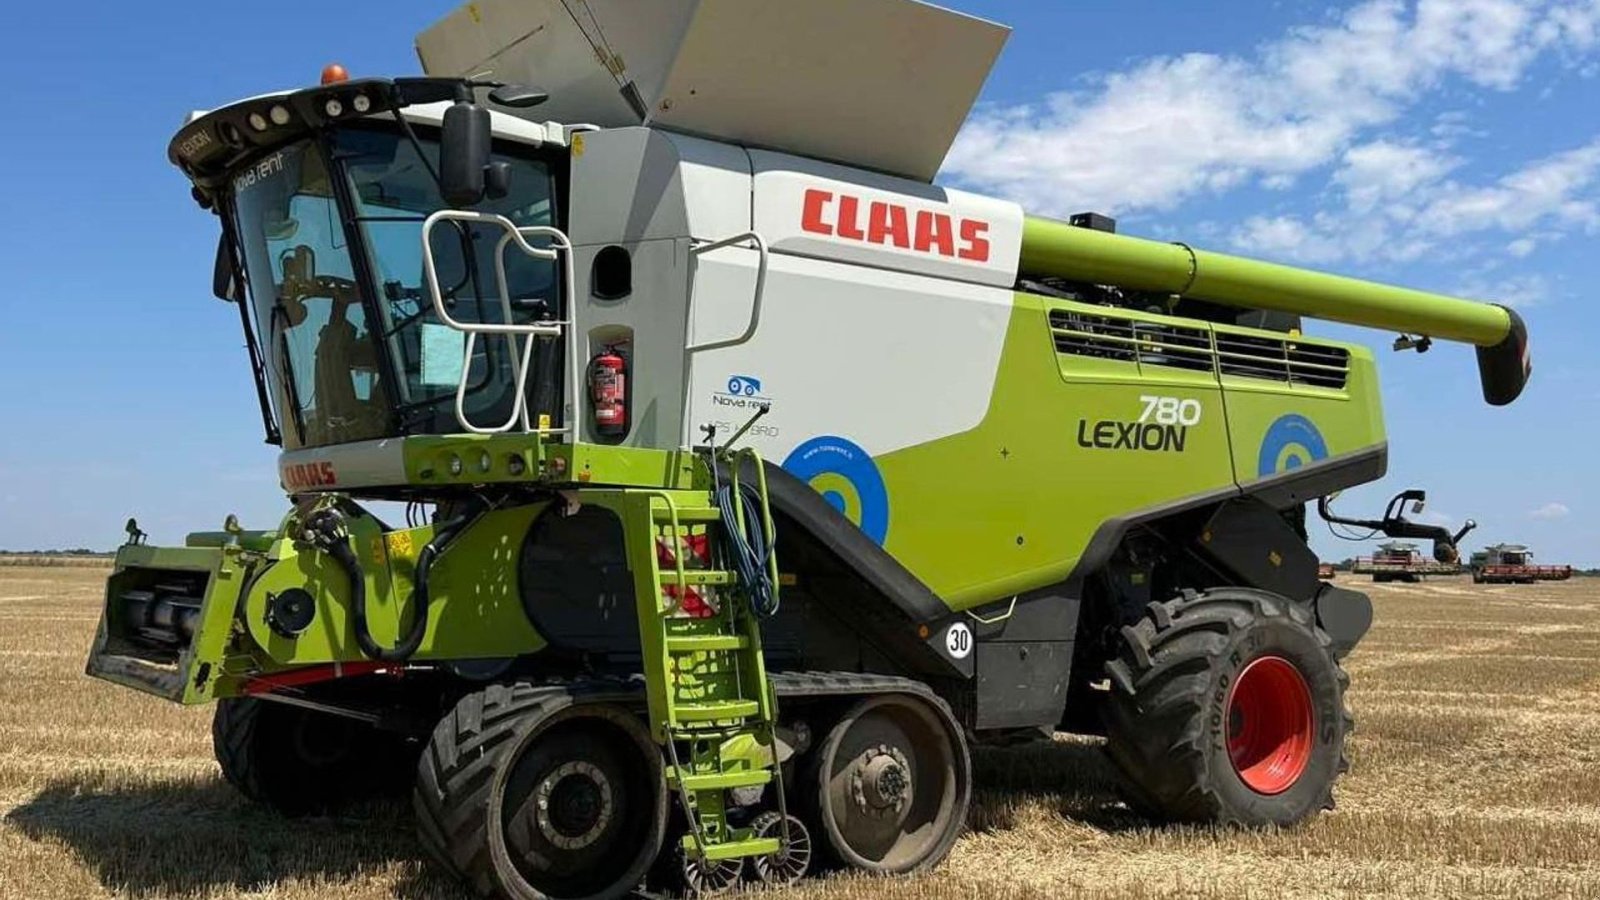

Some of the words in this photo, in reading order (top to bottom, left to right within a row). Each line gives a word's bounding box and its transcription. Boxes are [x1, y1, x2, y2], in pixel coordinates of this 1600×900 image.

[256, 152, 283, 180] rent
[801, 189, 990, 262] CLAAS
[713, 396, 745, 408] Nova
[1138, 396, 1201, 426] 780
[1078, 419, 1186, 452] LEXION
[285, 461, 336, 488] CLAAS
[950, 629, 967, 651] 30
